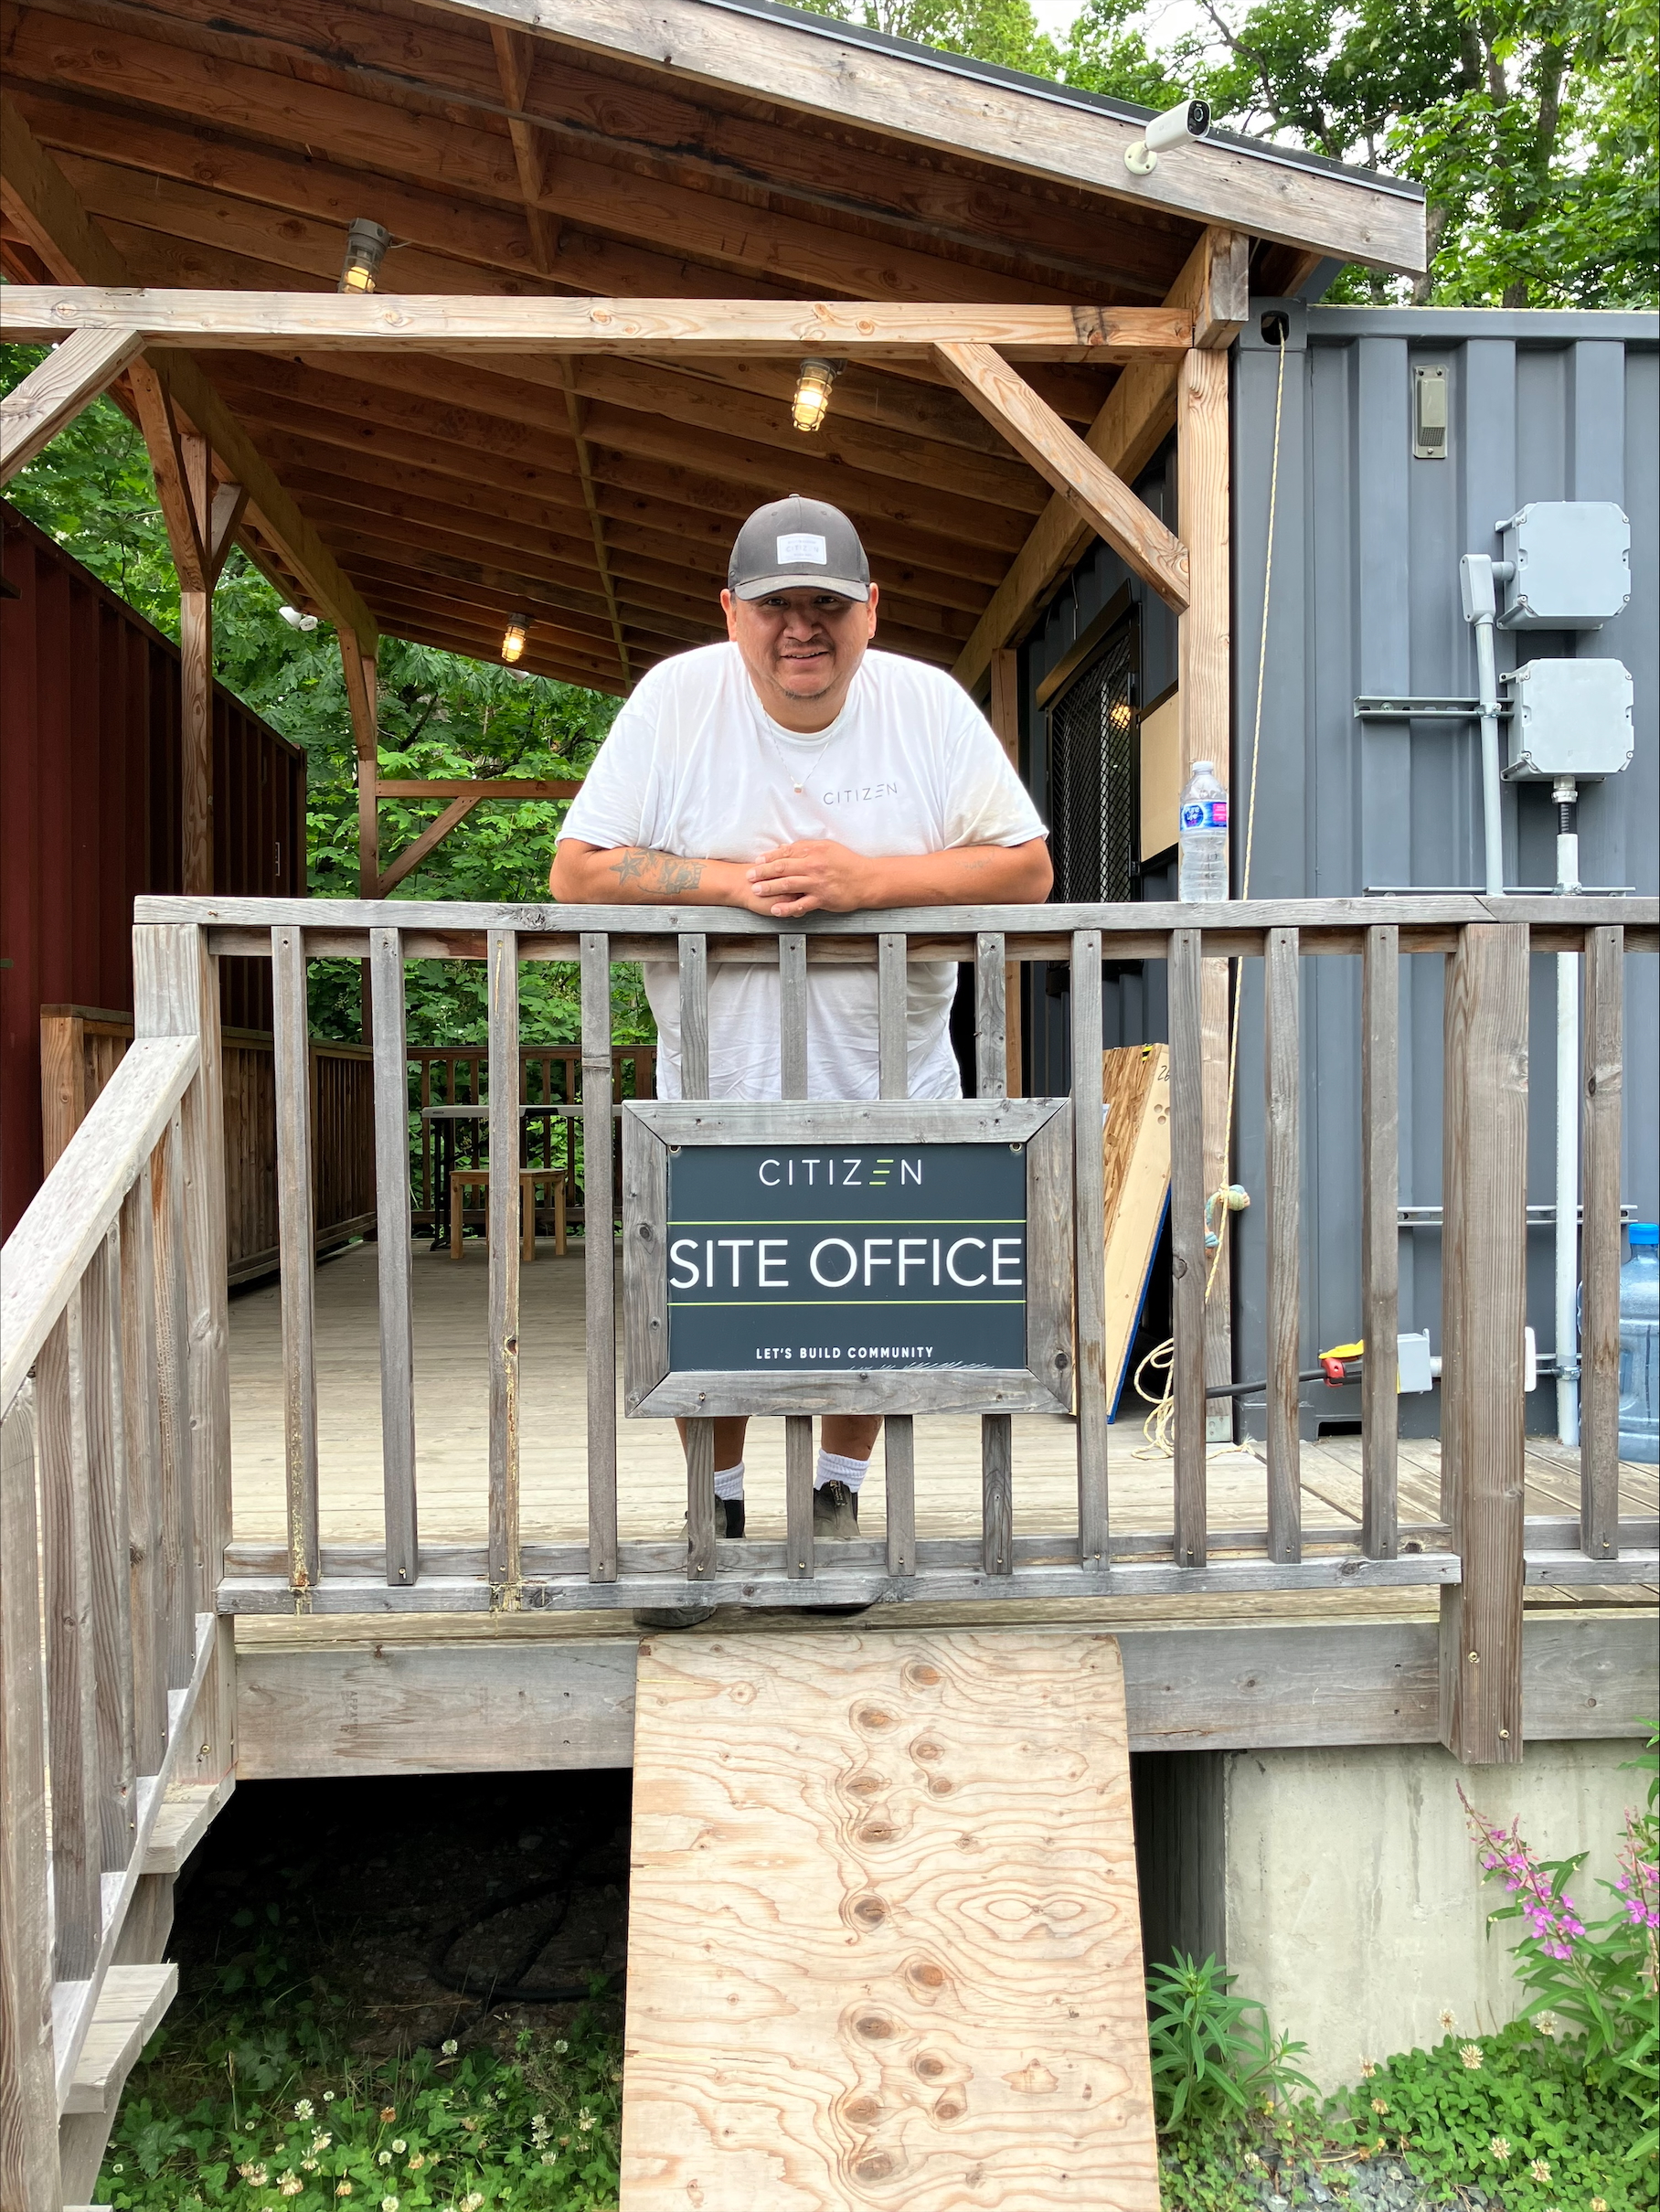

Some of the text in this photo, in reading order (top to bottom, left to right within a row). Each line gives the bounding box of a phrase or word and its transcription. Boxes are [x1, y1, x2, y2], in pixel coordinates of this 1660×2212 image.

[785, 545, 820, 553] CITIZN
[823, 782, 898, 805] CITIZEN
[759, 1159, 922, 1186] CITIZEN
[670, 1238, 1022, 1289] SITE OFFICE
[756, 1346, 933, 1359] LET'S BUILD COMMUNITY
